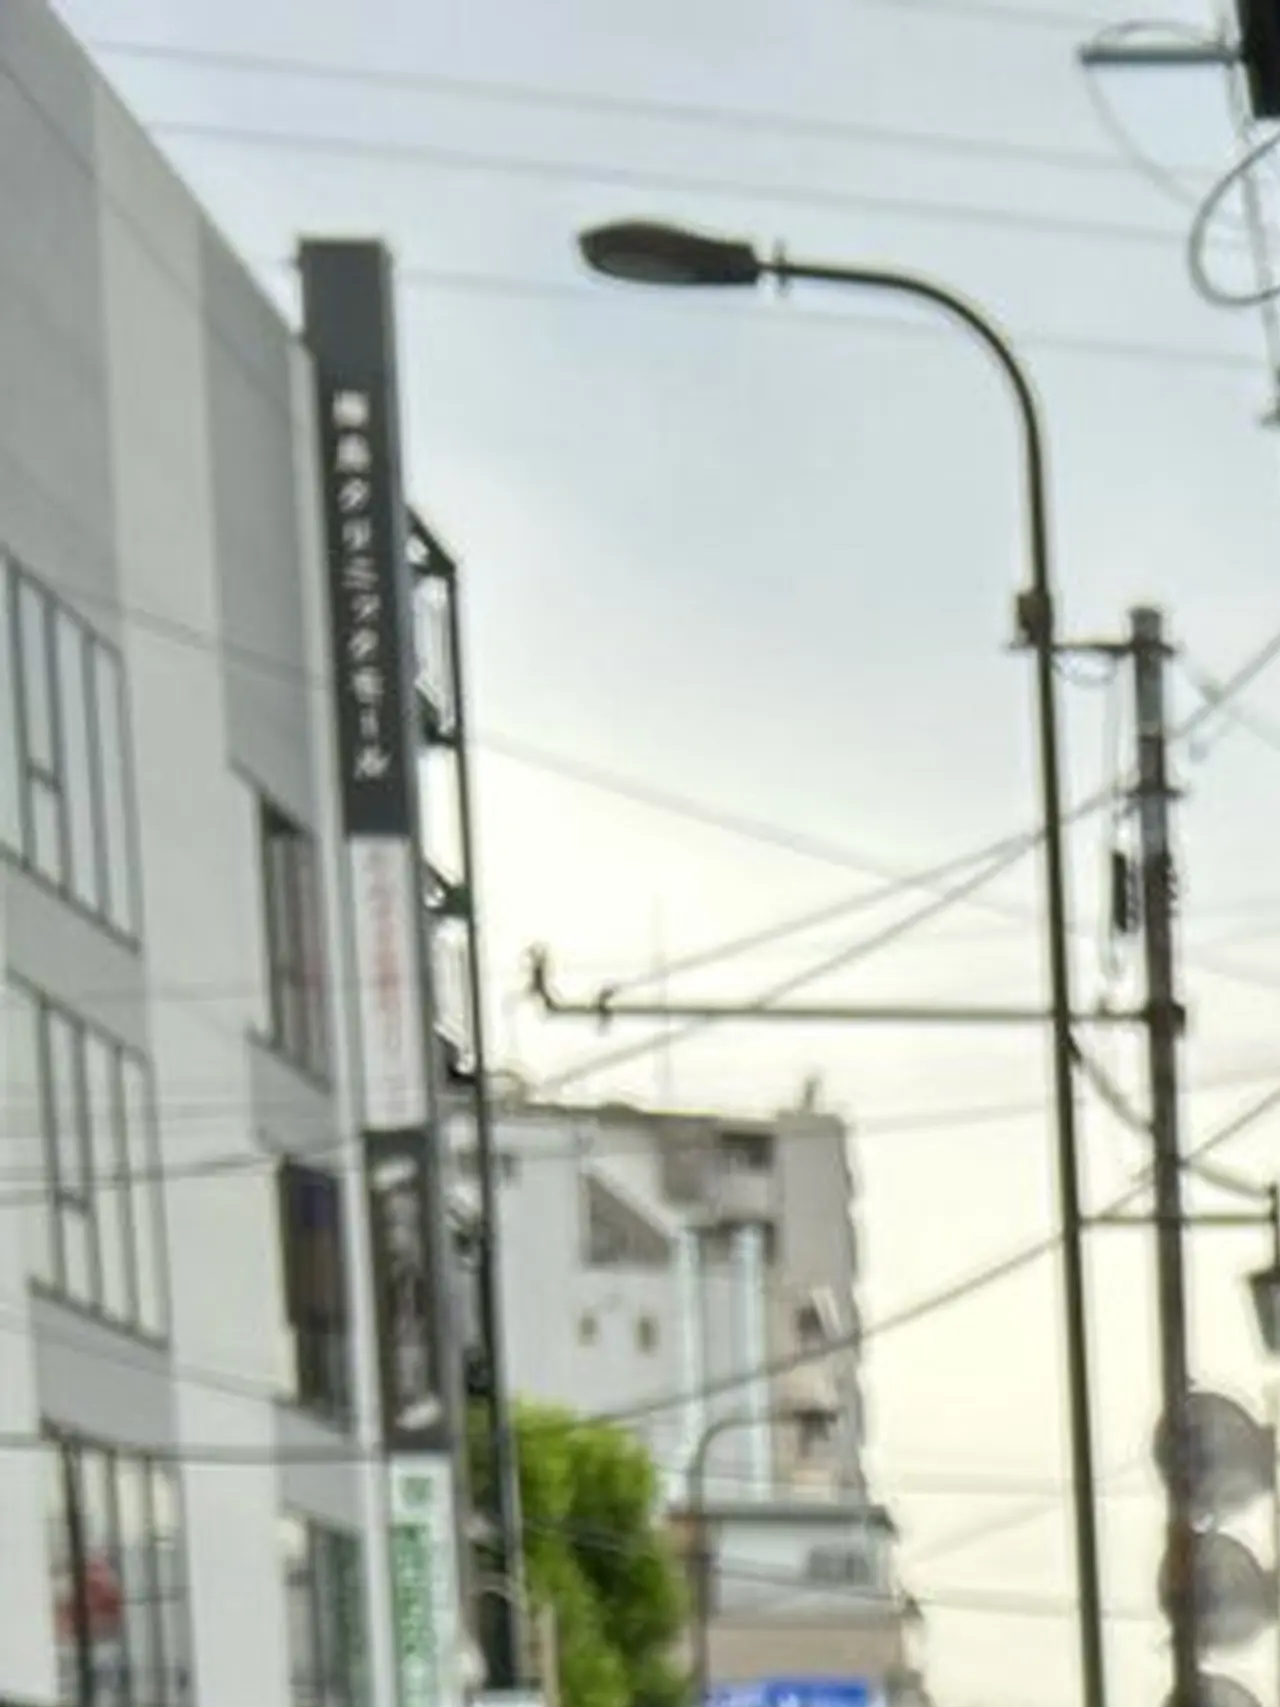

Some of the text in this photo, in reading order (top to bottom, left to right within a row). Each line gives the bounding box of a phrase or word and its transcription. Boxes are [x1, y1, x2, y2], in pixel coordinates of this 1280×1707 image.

[332, 388, 390, 778] クリニックモール
